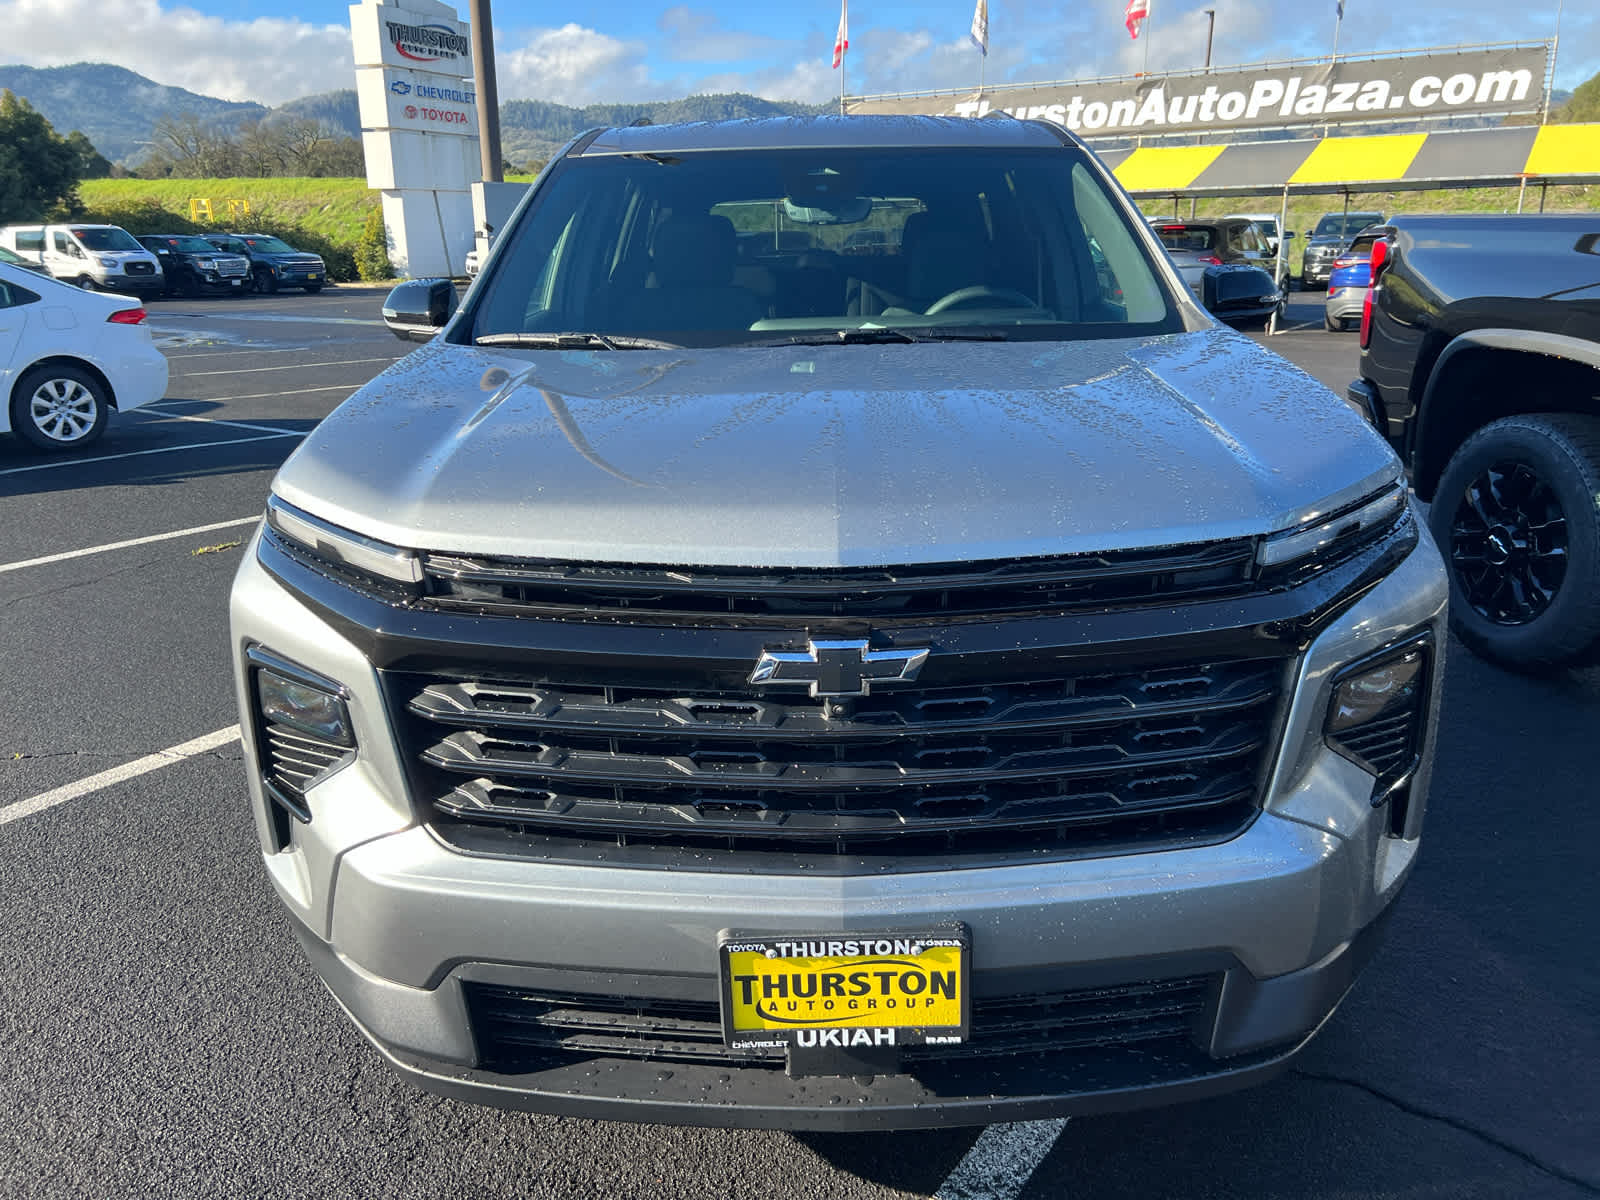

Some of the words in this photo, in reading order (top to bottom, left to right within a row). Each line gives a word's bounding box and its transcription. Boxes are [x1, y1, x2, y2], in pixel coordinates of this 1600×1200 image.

[386, 21, 469, 56] THURSTON
[416, 85, 476, 104] CHEVROLET
[421, 107, 468, 123] TOYOTA
[727, 944, 766, 952] TOYOTA
[775, 940, 910, 958] THURSTON
[734, 971, 956, 1005] THURSTON
[769, 1000, 834, 1012] AUTO
[848, 998, 935, 1009] GROUP
[732, 1040, 789, 1049] CHEVROLET
[796, 1028, 895, 1047] UKIAH
